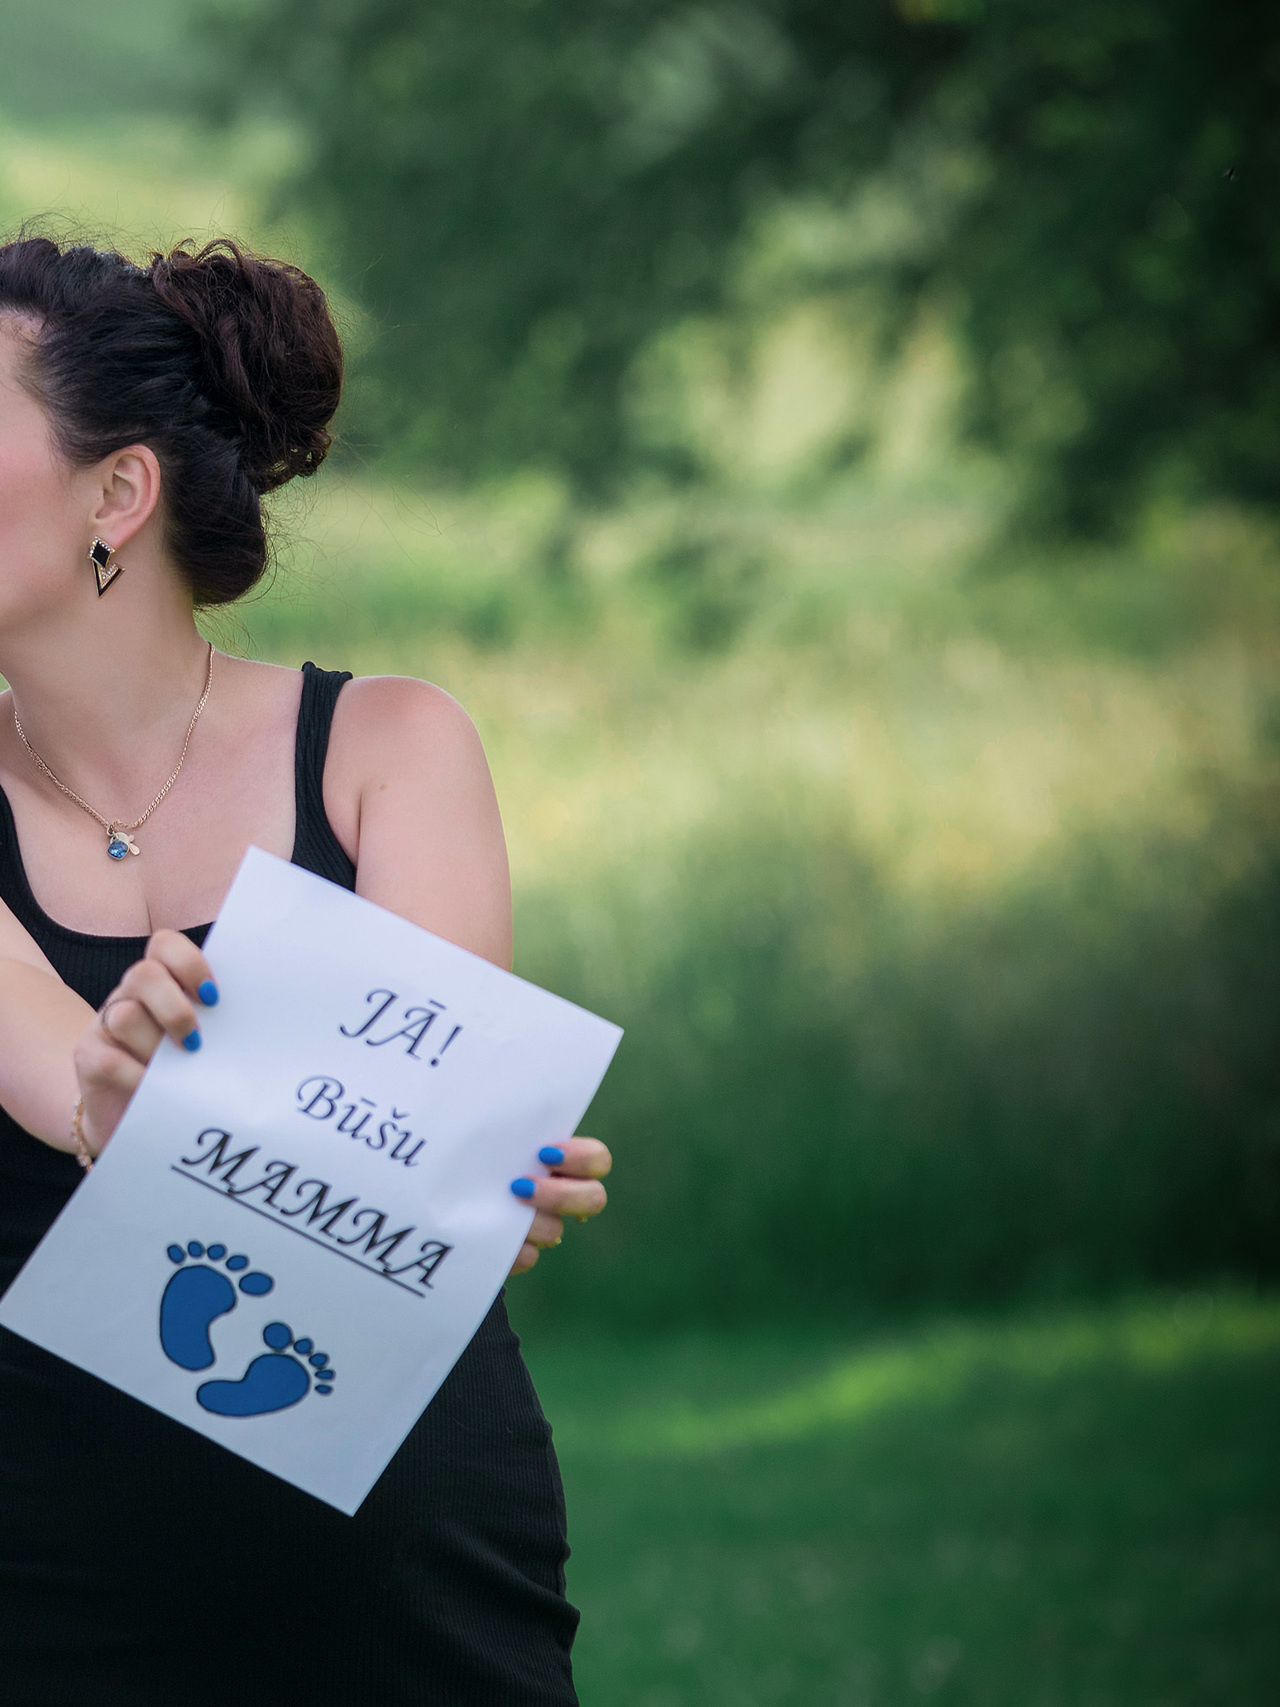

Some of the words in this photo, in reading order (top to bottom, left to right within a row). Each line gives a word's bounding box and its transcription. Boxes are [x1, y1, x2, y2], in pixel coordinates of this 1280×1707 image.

[339, 988, 463, 1068] JĀ!
[296, 1075, 429, 1169] Būšu
[180, 1127, 454, 1290] MAMMA
